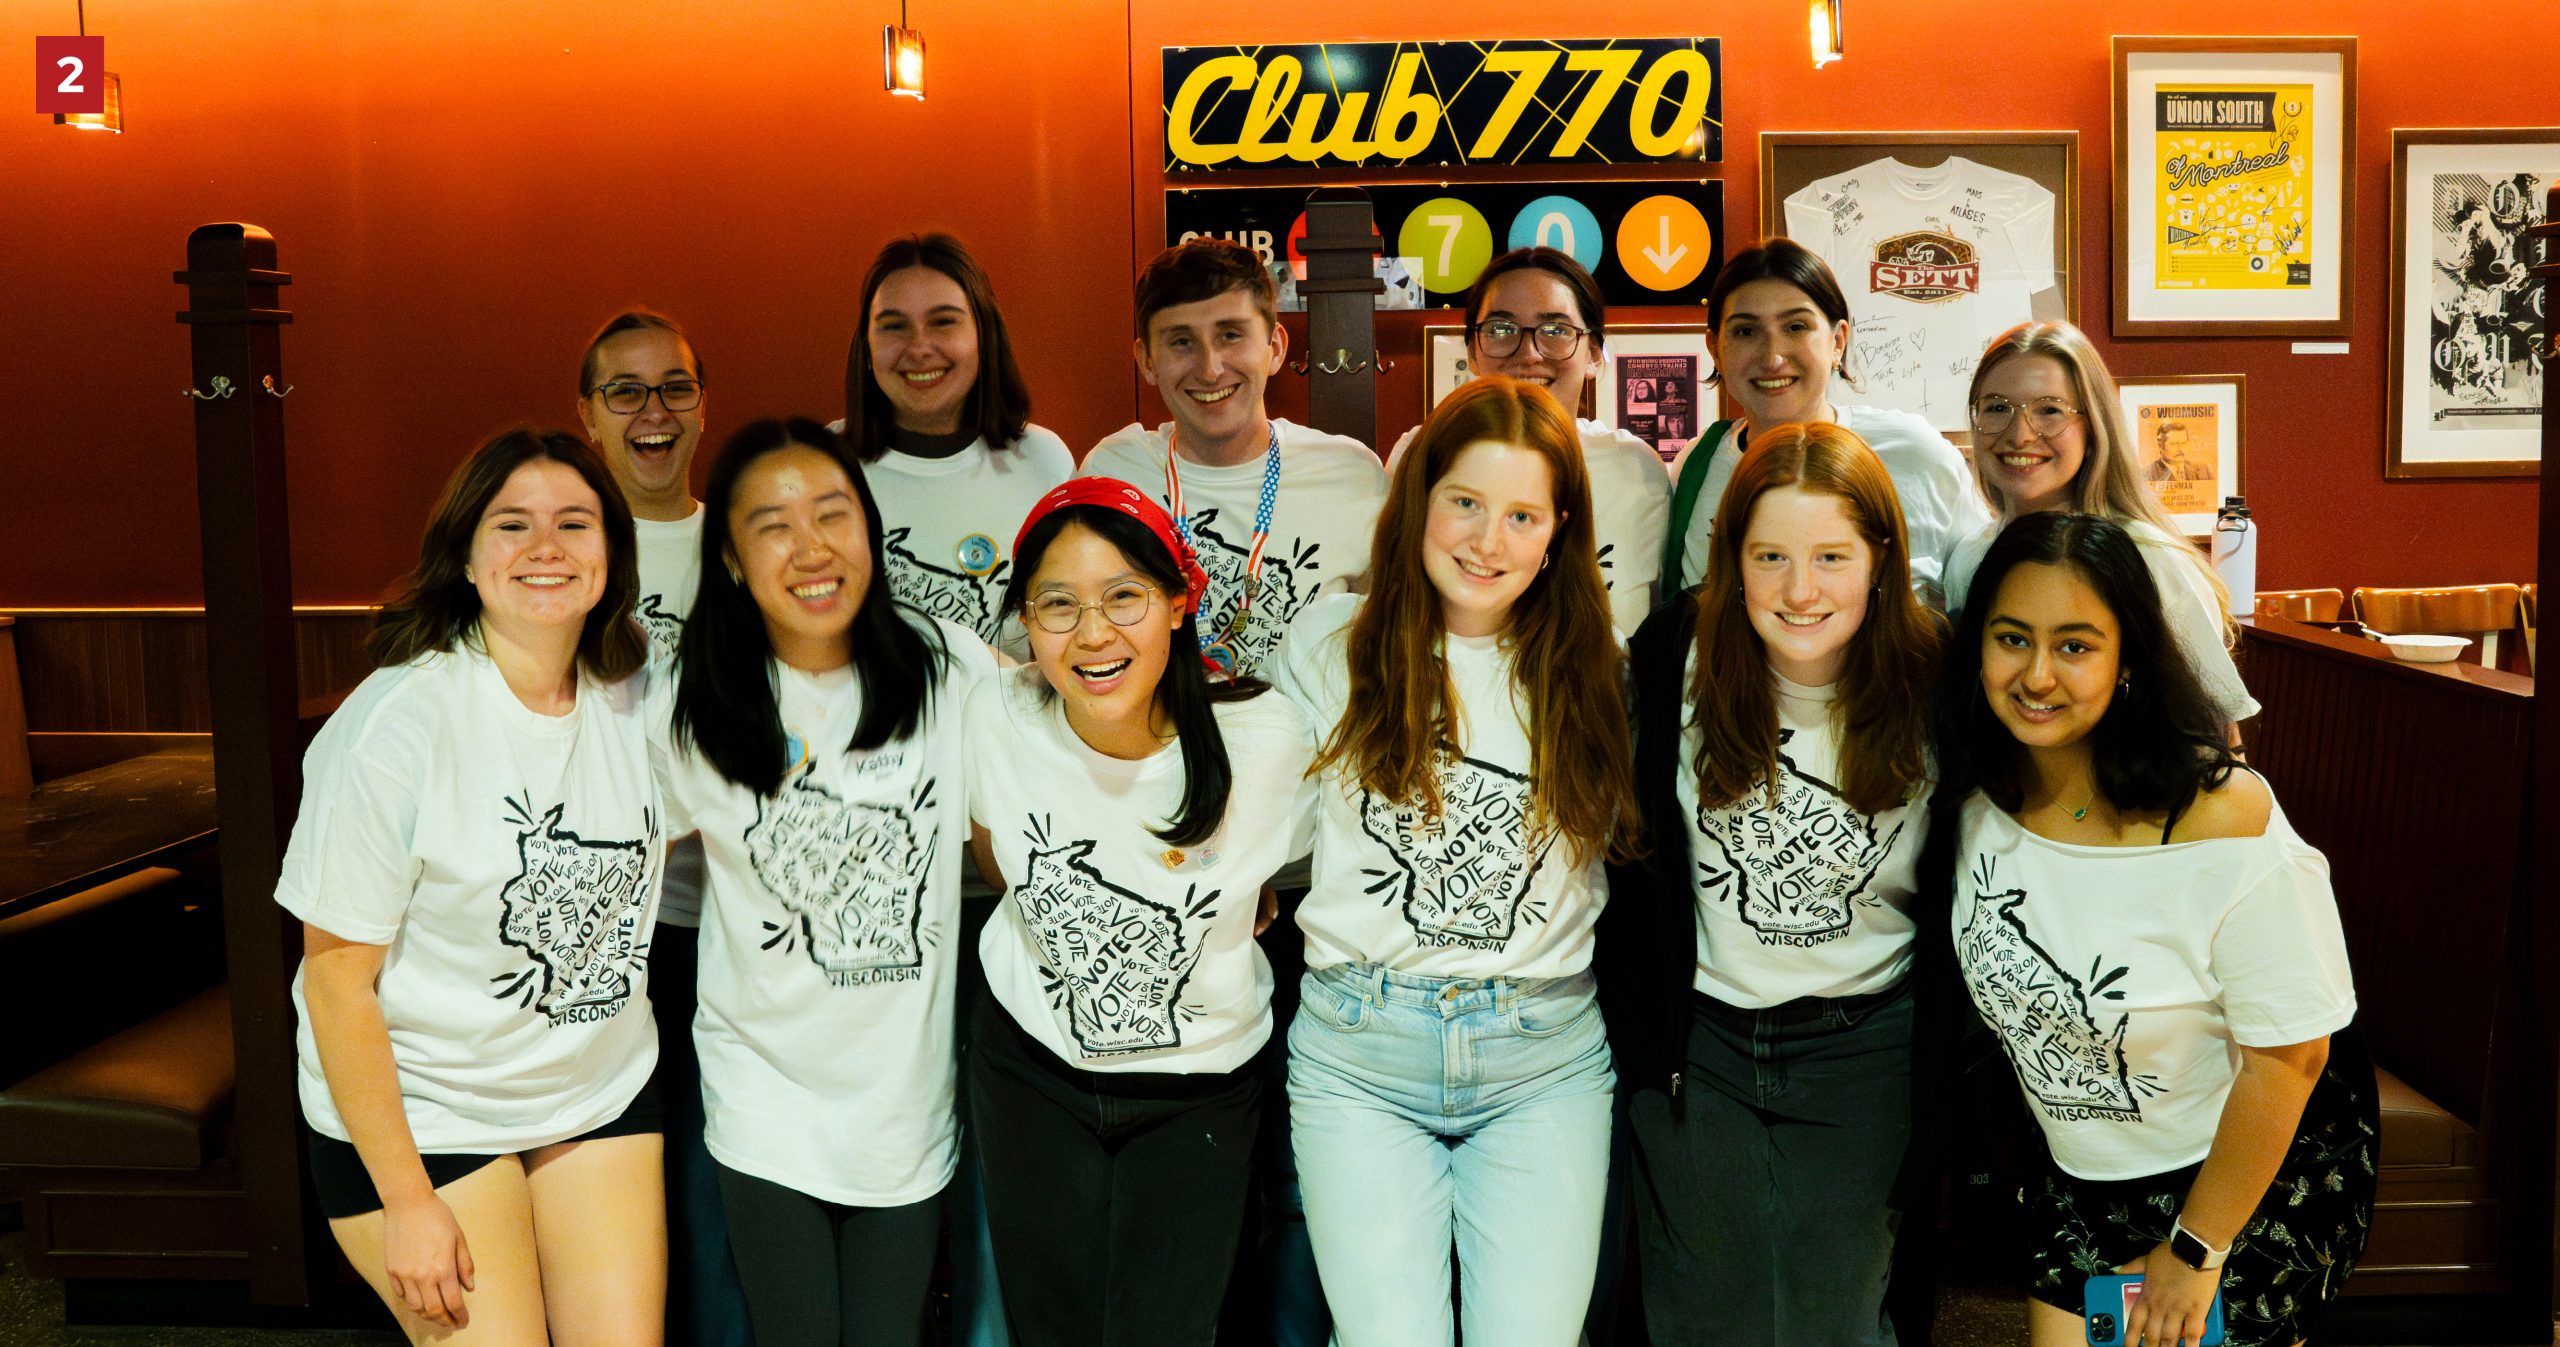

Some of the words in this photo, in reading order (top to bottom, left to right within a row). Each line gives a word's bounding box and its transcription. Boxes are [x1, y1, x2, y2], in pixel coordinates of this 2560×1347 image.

[1167, 53, 1441, 164] Club
[1468, 48, 1712, 159] 770
[2167, 100, 2212, 123] UNION
[2217, 100, 2263, 123] SOUTH
[2166, 155, 2187, 178] of
[2170, 142, 2289, 190] Montreal
[1950, 204, 1985, 223] ATLASES
[1179, 231, 1274, 267] CUB
[1427, 215, 1463, 277] 7
[1877, 267, 1973, 289] SETT
[1196, 540, 1219, 553] VOTE
[888, 557, 909, 570] VOTE
[1200, 556, 1219, 567] VOTE
[1218, 556, 1238, 572] VOTE
[1207, 568, 1230, 589] VOTE
[1267, 570, 1284, 590] VOTE
[899, 586, 923, 607] VOTE
[922, 578, 975, 625] VOTE
[959, 586, 975, 607] VOTE
[1255, 637, 1267, 664] VOTE
[1458, 772, 1481, 793] VOTE
[1369, 802, 1393, 815] VOTE
[1441, 789, 1470, 814] VOTE
[1737, 797, 1760, 811] VOTE
[1785, 787, 1811, 805] VOTE
[1471, 778, 1529, 847] VOTE
[1703, 814, 1726, 833] VOTE
[1843, 808, 1862, 835] VOTE
[1368, 816, 1392, 835] VOTE
[1396, 812, 1413, 851] VOTE
[1728, 814, 1745, 852] VOTE
[1748, 807, 1774, 849] VOTE
[1775, 820, 1790, 837] VOTE
[1800, 794, 1858, 863] VOTE
[530, 839, 550, 852] VOTE
[554, 845, 578, 857] VOTE
[846, 811, 900, 871] VOTE
[1434, 814, 1492, 865] VOTE
[1479, 840, 1515, 861] VOTE
[1766, 828, 1821, 870] VOTE
[564, 860, 584, 880] VOTE
[828, 849, 867, 897] VOTE
[1040, 859, 1064, 877] VOTE
[1414, 850, 1443, 879] VOTE
[1746, 852, 1773, 881] VOTE
[1808, 854, 1842, 872] VOTE
[521, 857, 564, 904] VOTE
[575, 877, 598, 894] VOTE
[1068, 873, 1096, 891] VOTE
[1424, 856, 1496, 913] VOTE
[1494, 862, 1522, 900] VOTE
[1755, 867, 1828, 914] VOTE
[1820, 878, 1835, 900] VOTE
[1830, 873, 1855, 899] VOTE
[556, 889, 580, 933] VOTE
[891, 886, 907, 927] VOTE
[1026, 881, 1074, 920] VOTE
[1071, 894, 1097, 909] VOTE
[1093, 896, 1118, 914] VOTE
[1416, 900, 1440, 919] VOTE
[1752, 902, 1776, 918] VOTE
[1798, 893, 1820, 907] VOTE
[510, 905, 534, 923] VOTE
[572, 891, 612, 950] VOTE
[820, 885, 885, 946] VOTE
[1047, 909, 1071, 925] VOTE
[1081, 909, 1109, 933] VOTE
[1466, 899, 1500, 936] VOTE
[1763, 920, 1820, 929] vote.wisc.edu
[1805, 901, 1841, 928] VOTE
[1979, 904, 1994, 924] VOTE
[509, 925, 533, 935] VOTE
[537, 908, 552, 948] VOTE
[615, 917, 634, 960] VOTE
[1062, 918, 1089, 962] VOTE
[1086, 928, 1102, 944] VOTE
[1109, 902, 1167, 962] VOTE
[1151, 917, 1171, 940] VOTE
[1756, 927, 1850, 948] WISCONSIN
[1995, 923, 2019, 946] VOTE
[551, 939, 576, 966] VOTE
[608, 928, 616, 962] VOTE
[869, 927, 907, 964] VOTE
[1043, 927, 1062, 966] VOTE
[1415, 934, 1506, 953] WISCONSIN
[1965, 930, 1997, 969] VOTE
[1993, 950, 2015, 962] VOTE
[586, 953, 605, 977] VOTE
[1080, 934, 1132, 985] VOTE
[1120, 957, 1154, 975] VOTE
[2013, 956, 2037, 974] VOTE
[824, 968, 922, 986] WISCONSIN
[1063, 967, 1091, 999] VOTE
[2001, 964, 2029, 996] VOTE
[1078, 970, 1142, 1032] VOTE
[1137, 982, 1150, 1008] VOTE
[1148, 976, 1169, 1008] VOTE
[1974, 978, 1997, 1018] VOTE
[1986, 973, 2017, 1014] VOTE
[2027, 965, 2082, 1031] VOTE
[2063, 990, 2078, 1017] VOTE
[549, 998, 630, 1029] WISCONSIN
[1120, 997, 1136, 1023] VOTE
[1160, 1007, 1168, 1025] VOTE
[1128, 1009, 1166, 1045] VOTE
[2001, 1019, 2031, 1050] VOTE
[1088, 1036, 1143, 1047] vote.wisc.edu
[2022, 1033, 2081, 1084] VOTE
[2065, 1060, 2082, 1080] VOTE
[2026, 1071, 2048, 1090] VOTE
[2076, 1072, 2120, 1107] VOTE
[2041, 1102, 2142, 1122] WISCONSIN
